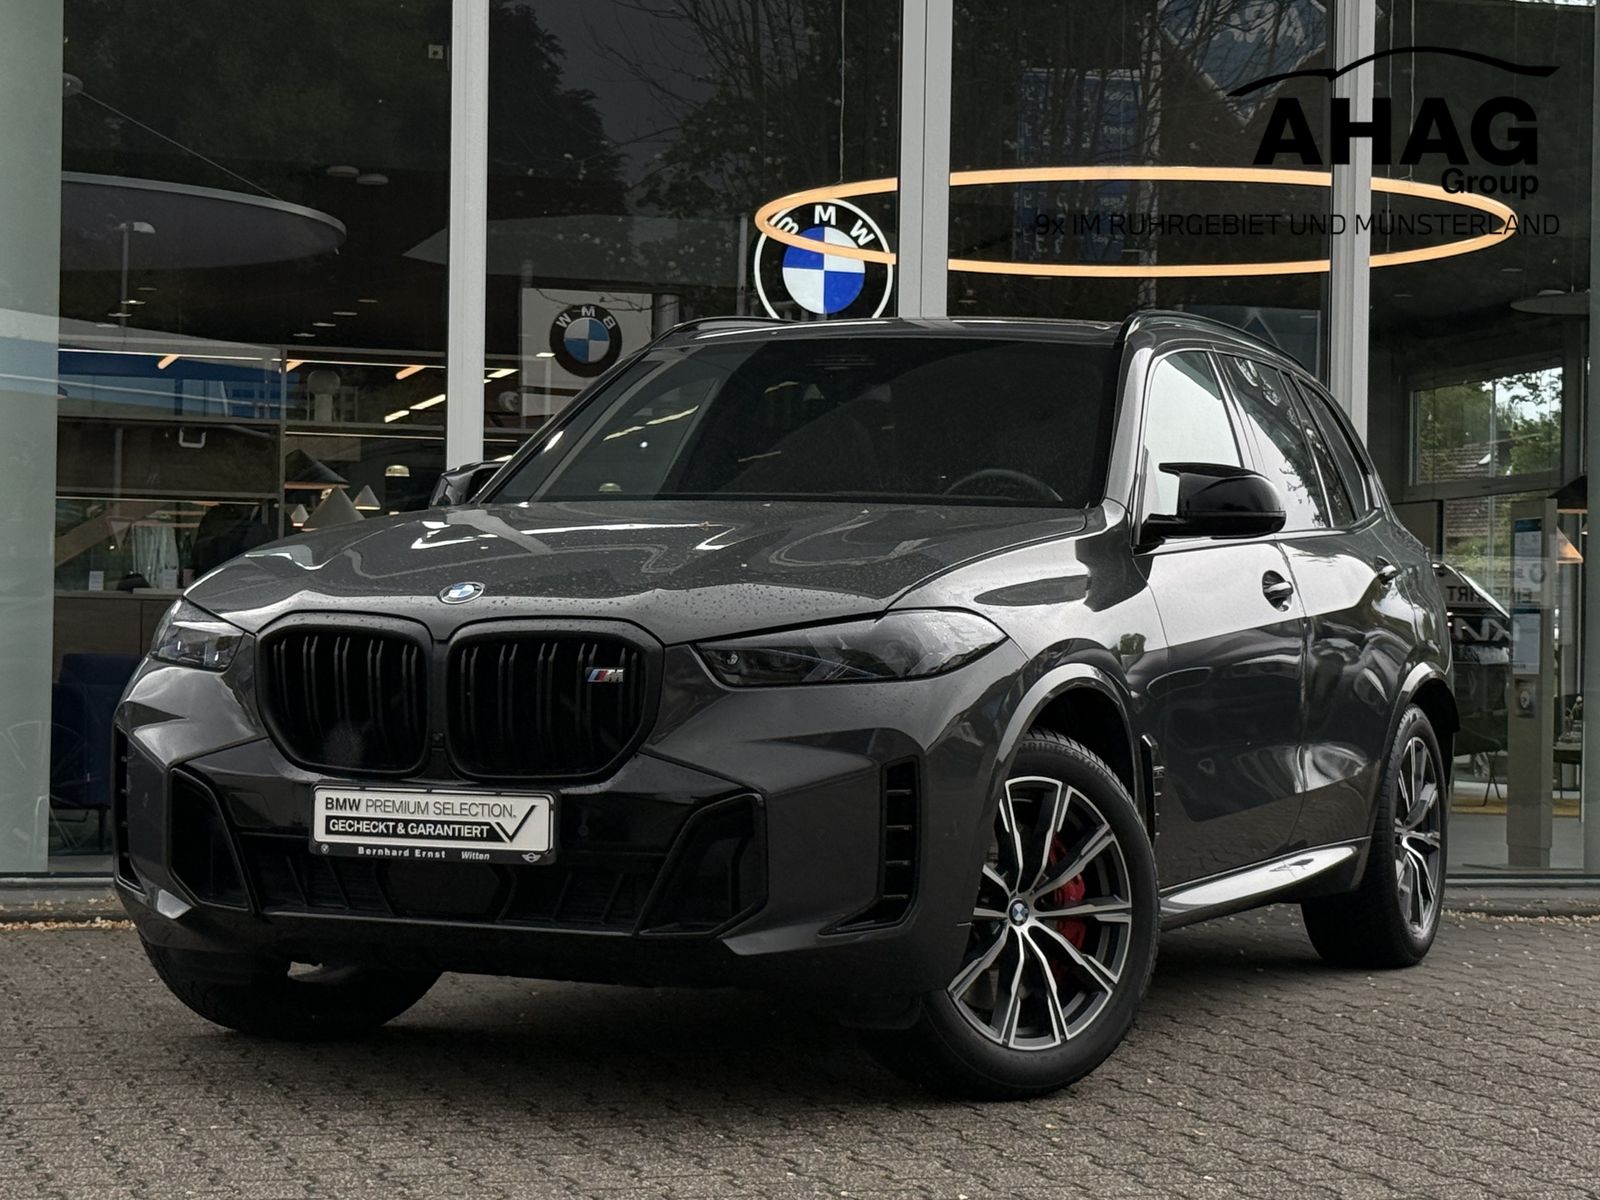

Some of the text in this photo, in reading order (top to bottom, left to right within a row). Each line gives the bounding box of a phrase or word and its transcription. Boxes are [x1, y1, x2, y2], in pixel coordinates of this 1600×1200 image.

[325, 797, 361, 811] BMW
[365, 798, 430, 815] PREMIUM
[329, 818, 490, 838] GECHECKT & GARANTIERT
[358, 846, 491, 861] Bernhard Ernst Witten
